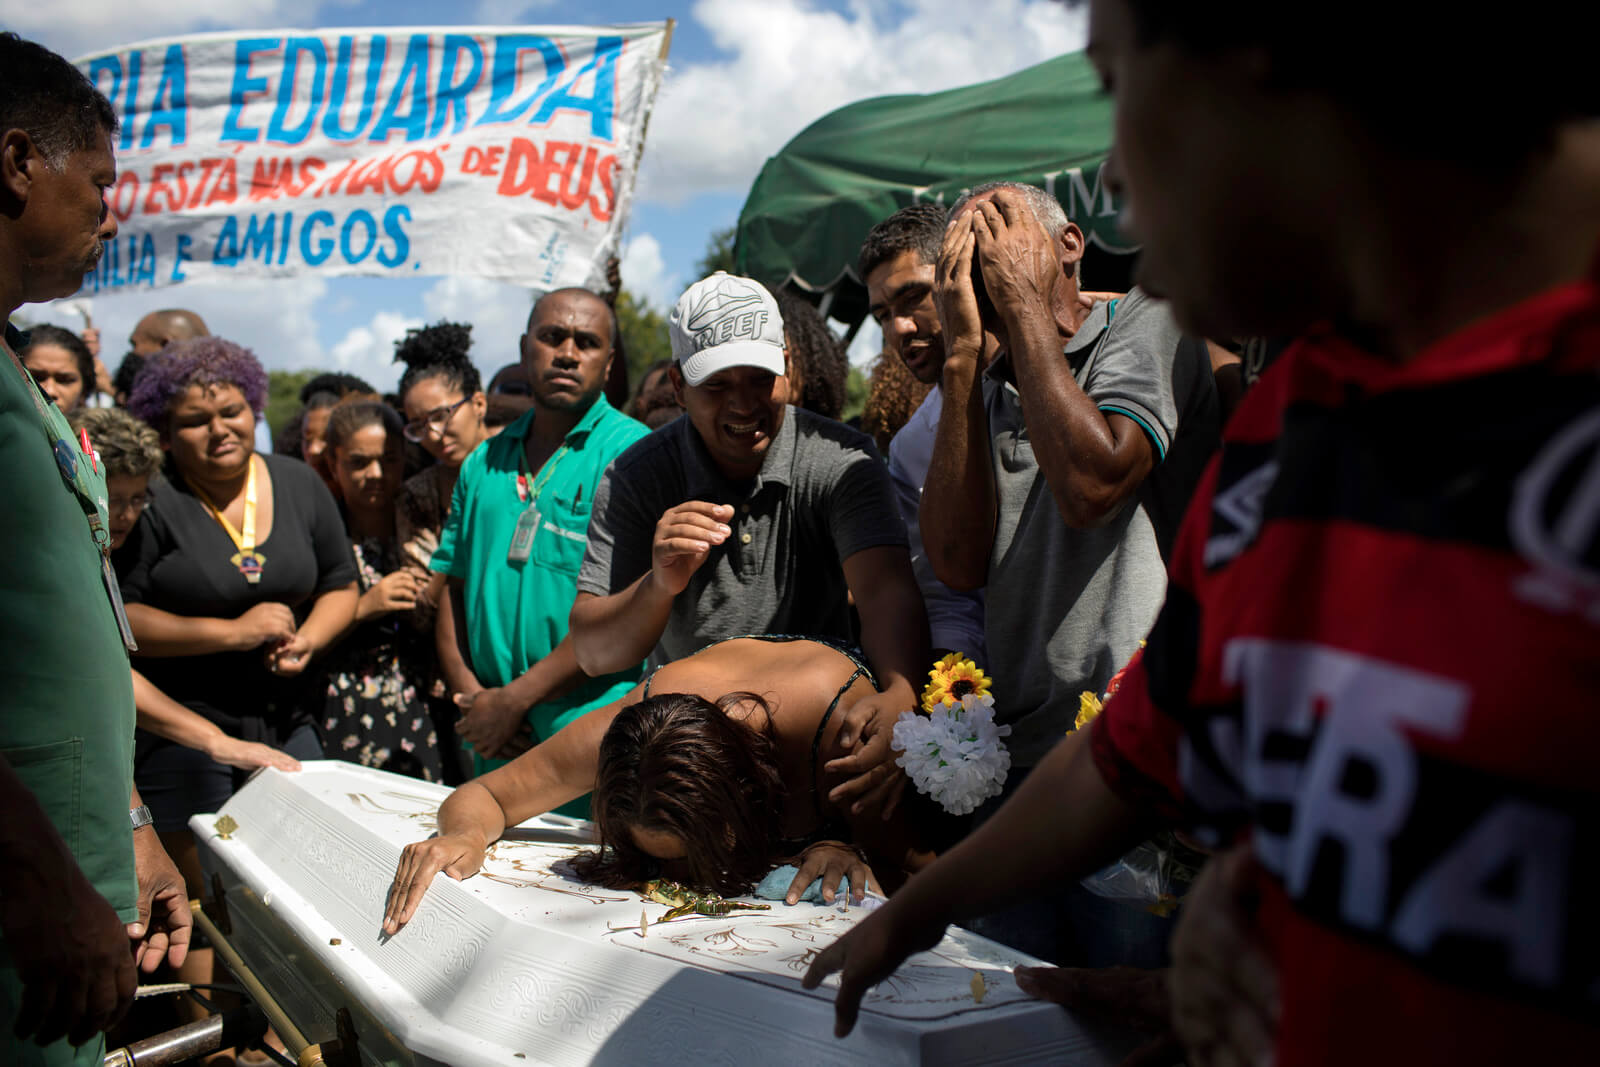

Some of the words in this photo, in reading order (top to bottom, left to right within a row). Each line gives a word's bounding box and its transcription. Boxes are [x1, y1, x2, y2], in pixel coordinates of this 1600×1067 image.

[219, 34, 626, 143] EDUARDA
[143, 143, 244, 217] ESTÁ
[460, 145, 505, 177] DE
[497, 137, 622, 222] DEUS
[171, 233, 194, 283] E
[212, 204, 421, 270] AMIGOS.
[693, 310, 769, 351] REEF
